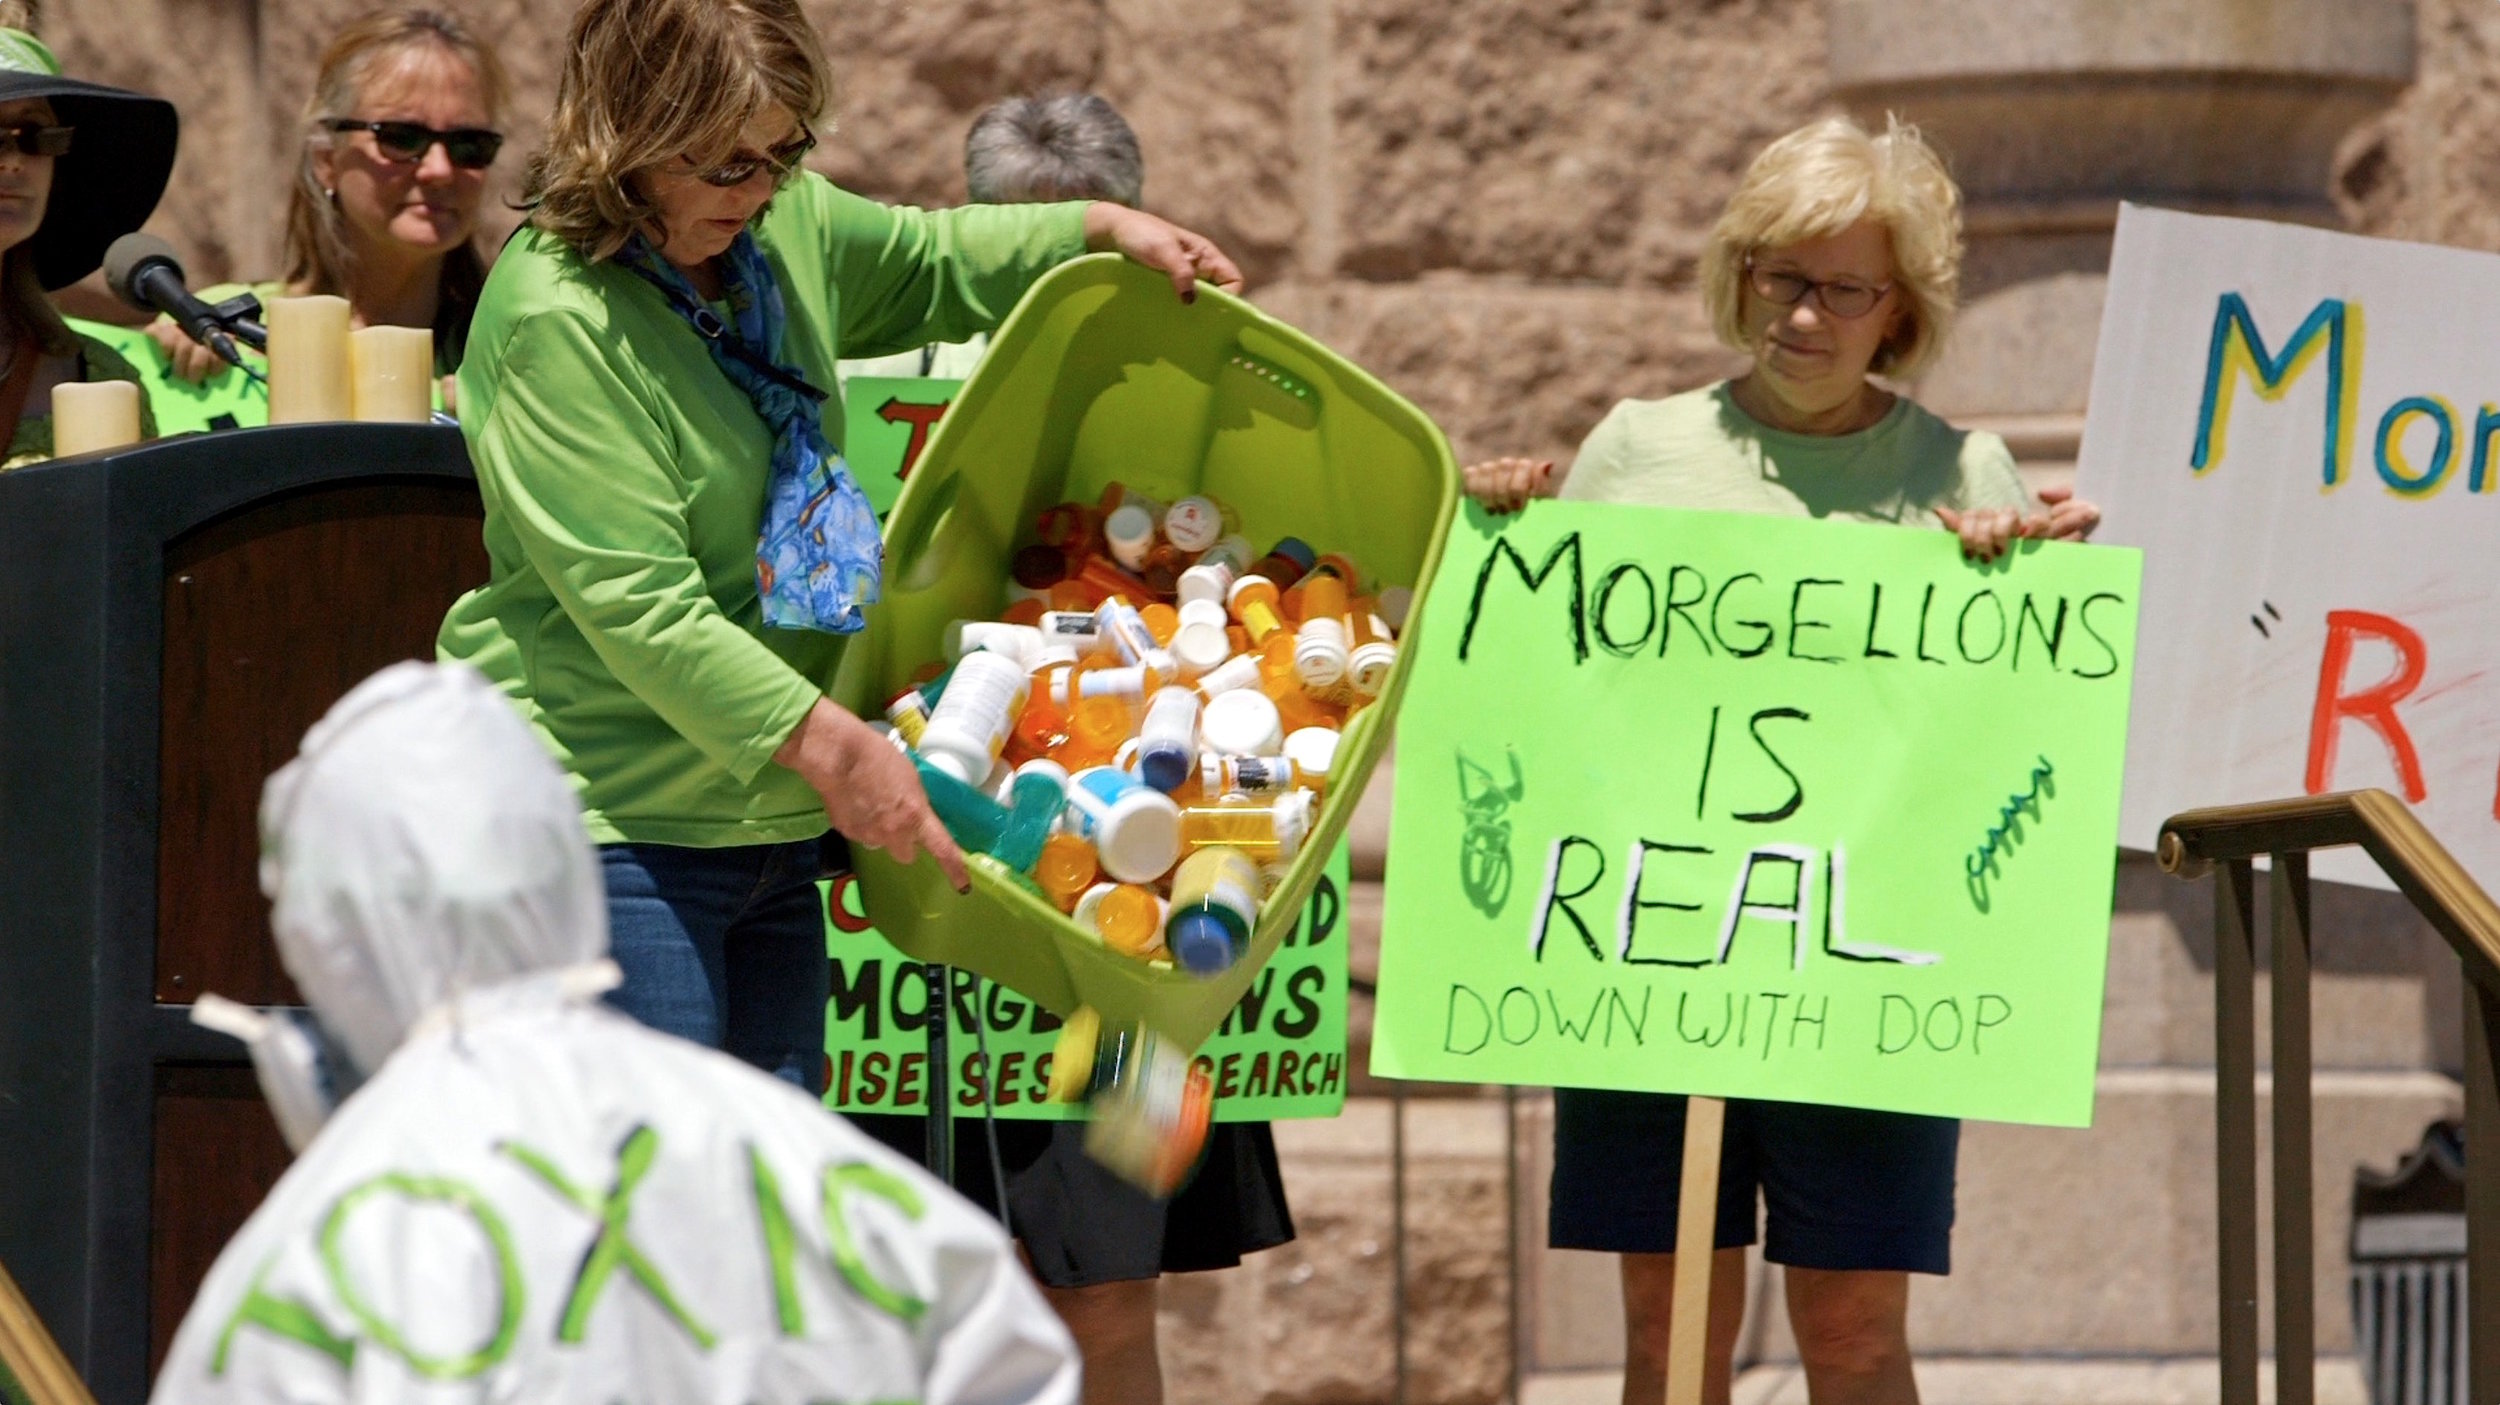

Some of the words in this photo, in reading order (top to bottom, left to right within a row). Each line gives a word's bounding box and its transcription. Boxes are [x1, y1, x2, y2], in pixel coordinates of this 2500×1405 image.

[1460, 532, 2124, 678] MORGELLONS
[1699, 706, 1810, 823] IS
[1531, 835, 1942, 969] REAL
[1445, 984, 1651, 1055] DOWN
[1679, 992, 1828, 1060] WITH
[1878, 994, 2012, 1055] DOP
[211, 1125, 928, 1378] TOXIC
